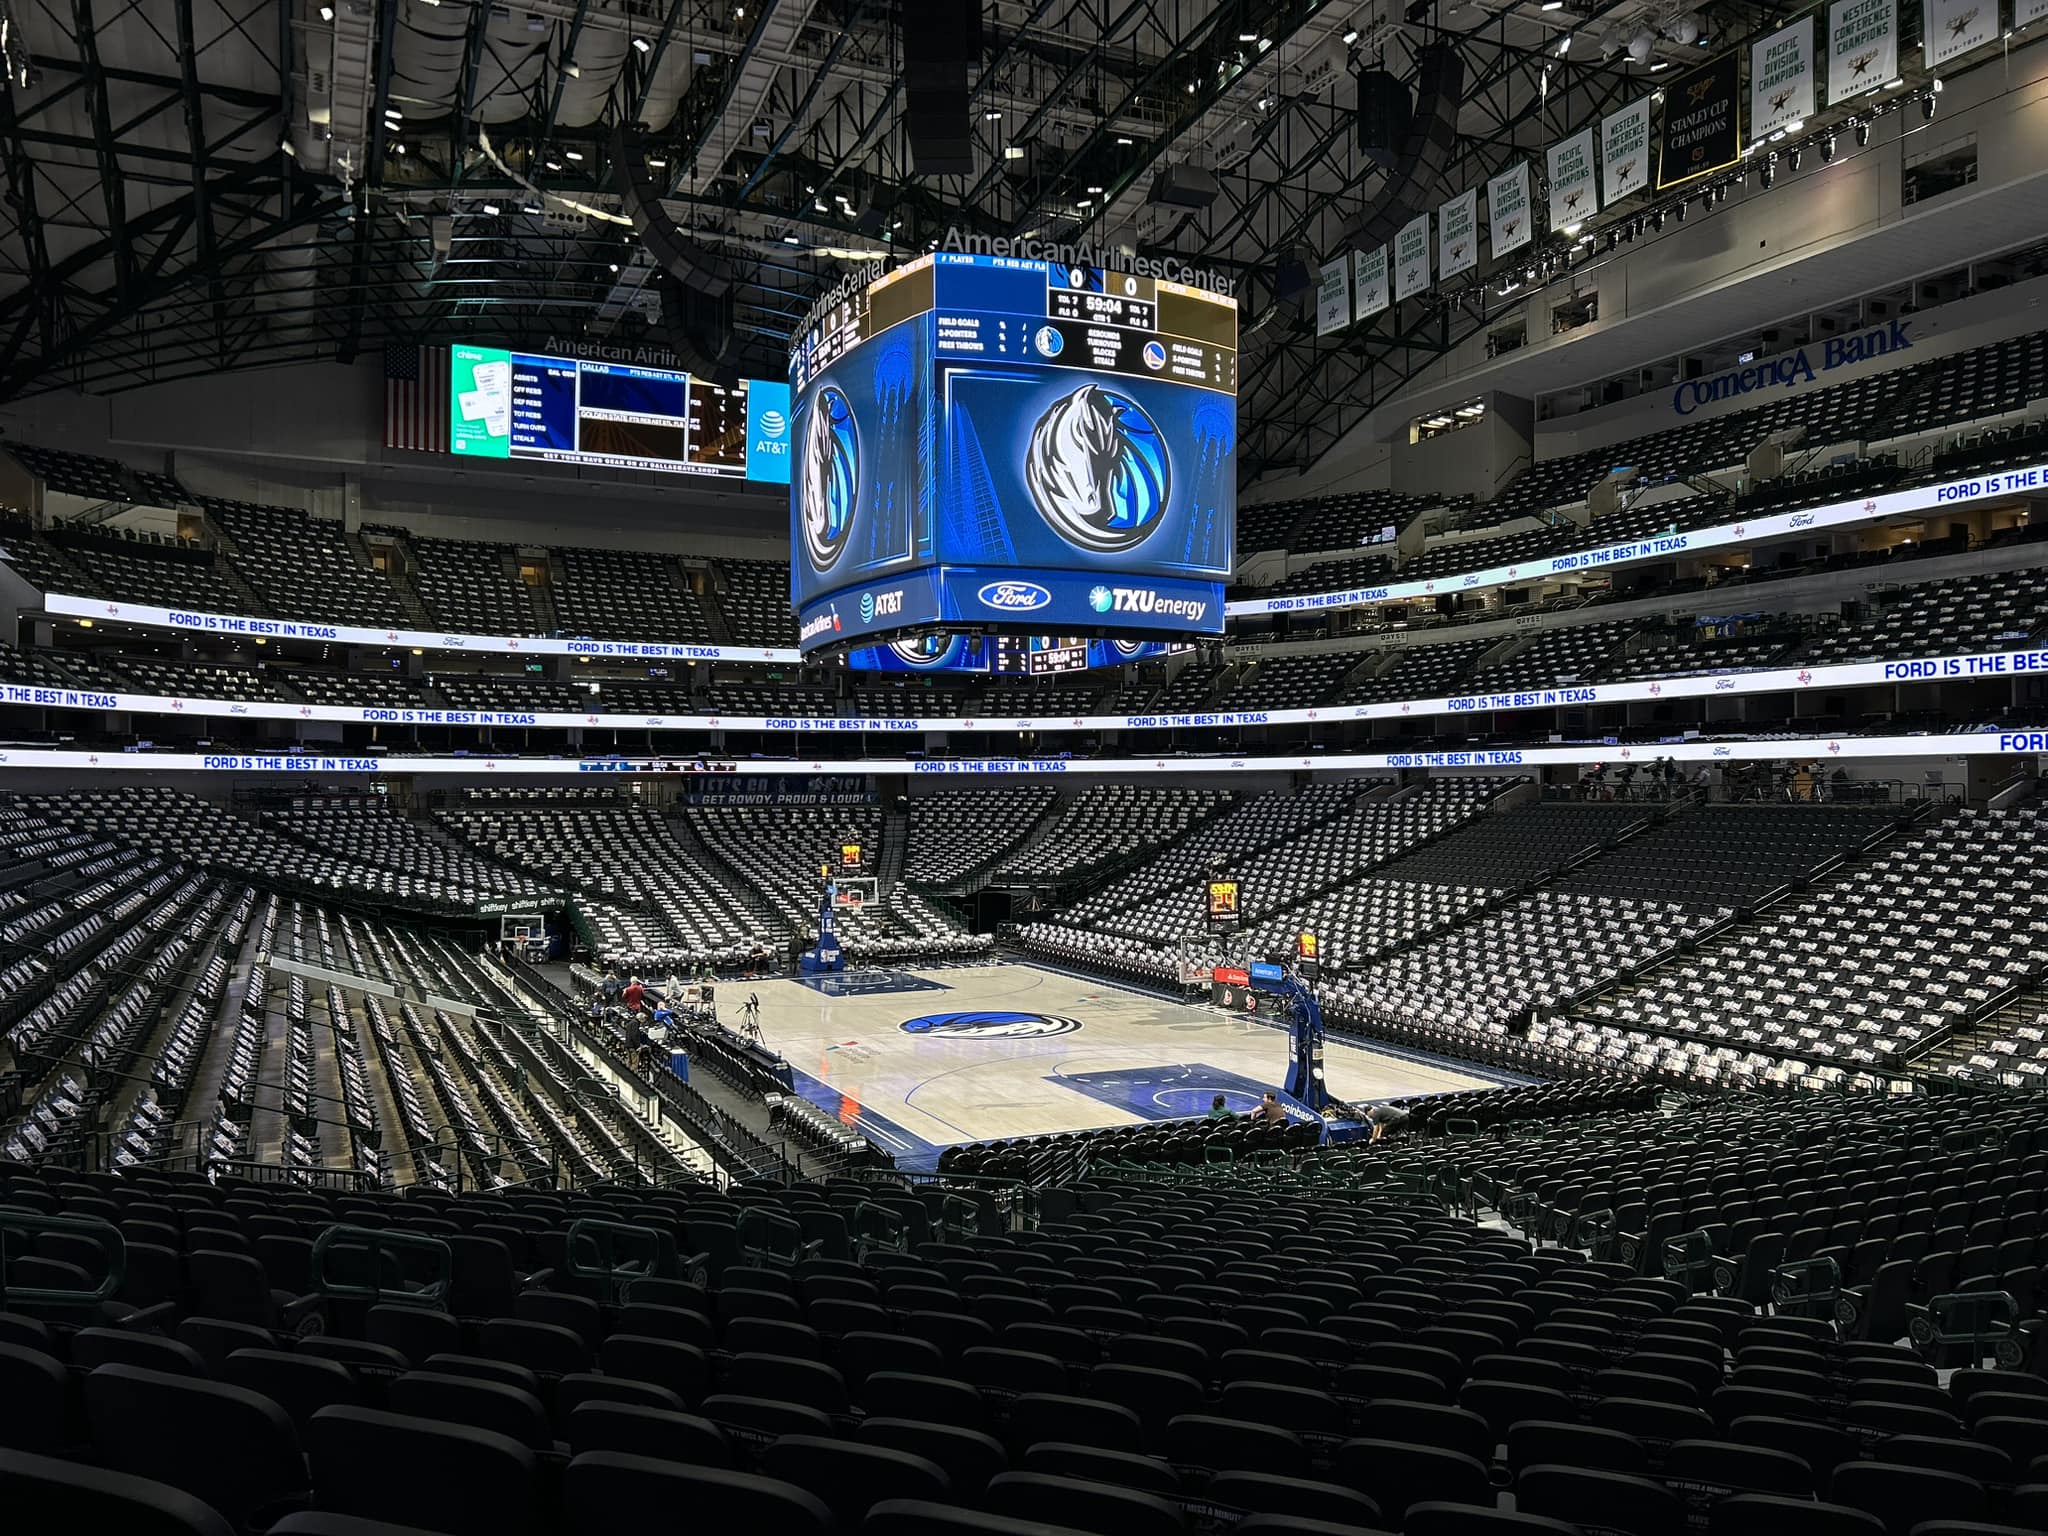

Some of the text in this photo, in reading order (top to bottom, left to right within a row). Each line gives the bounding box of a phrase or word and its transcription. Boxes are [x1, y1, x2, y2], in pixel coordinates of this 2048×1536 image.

[1834, 5, 1892, 42] CONFERENCE
[1766, 36, 1799, 60] PACIFIC
[1836, 22, 1889, 55] CHAMPIONS
[1764, 49, 1800, 76] DIVISION
[1758, 61, 1806, 92] CHAMPIONS
[1610, 112, 1640, 135] WESTERN
[1670, 99, 1729, 134] STANLEY CUP
[1605, 122, 1646, 151] CONFERENCE
[1671, 117, 1727, 149] CHAMPIONS
[1558, 144, 1582, 165] PACIFIC
[1607, 136, 1644, 163] CHAMPIONS
[1557, 156, 1585, 177] DIVISION
[1497, 176, 1519, 196] PACIFIC
[1554, 166, 1590, 192] CHAMPIONS
[1497, 187, 1521, 208] DIVISION
[1494, 197, 1526, 221] CHAMPIONS
[1447, 213, 1468, 231] DIVISION
[1401, 226, 1423, 244] CENTRAL
[1443, 222, 1473, 245] CHAMPIONS
[1400, 246, 1426, 266] CHAMPIONS
[1402, 238, 1422, 255] DIVISION
[948, 255, 974, 264] PLAYER
[1070, 268, 1083, 288] 0
[1125, 276, 1137, 297] 0
[1086, 296, 1122, 314] 59:04
[544, 335, 632, 361] American
[1822, 319, 1914, 372] Bank
[581, 363, 609, 374] DALLAS
[756, 440, 788, 455] AT&T
[1937, 471, 2038, 502] FORD IS THE
[1789, 512, 1815, 528] Ford
[1551, 534, 1688, 572] FORD IS THE BEST IN TEXAS
[1463, 575, 1480, 587] Ford
[874, 590, 904, 616] AT&T
[992, 584, 1036, 607] Ford
[1267, 589, 1389, 611] FORD IS THE BEST IN TEXAS
[168, 612, 337, 639] FORD IS THE BEST IN TEXAS
[443, 636, 465, 647] Ford
[567, 641, 721, 658] FORD IS THE BEST IN TEXAS
[1884, 661, 1937, 679] FORD
[1943, 658, 1961, 675] IS
[1967, 655, 2007, 674] THE
[1714, 678, 1735, 691] Ford
[7, 687, 117, 708] THE BEST IN TEXAS
[1447, 687, 1597, 711] FORD IS THE BEST IN TEXAS
[230, 704, 248, 714] Ford
[363, 709, 536, 725] FORD IS THE BEST IN TEXAS
[765, 718, 918, 731] FORD IS THE BEST IN TEXAS
[1127, 712, 1268, 727] FORD IS THE BEST IN TEXAS
[1386, 751, 1523, 767] FORD IS THE BEST IN TEXAS
[1712, 746, 1730, 757] Ford
[203, 756, 379, 771] FORD IS THE BEST IN TEXAS
[914, 760, 1067, 773] FORD IS THE BEST IN TEXAS
[702, 794, 725, 805] GET
[777, 794, 817, 804] PROUD
[830, 793, 864, 805] LOUD!
[480, 903, 509, 914] shiftkey
[511, 899, 538, 911] shiftkey
[1213, 894, 1235, 912] 24
[1281, 1102, 1315, 1122] coinbase
[1186, 1503, 1213, 1515] MISS A
